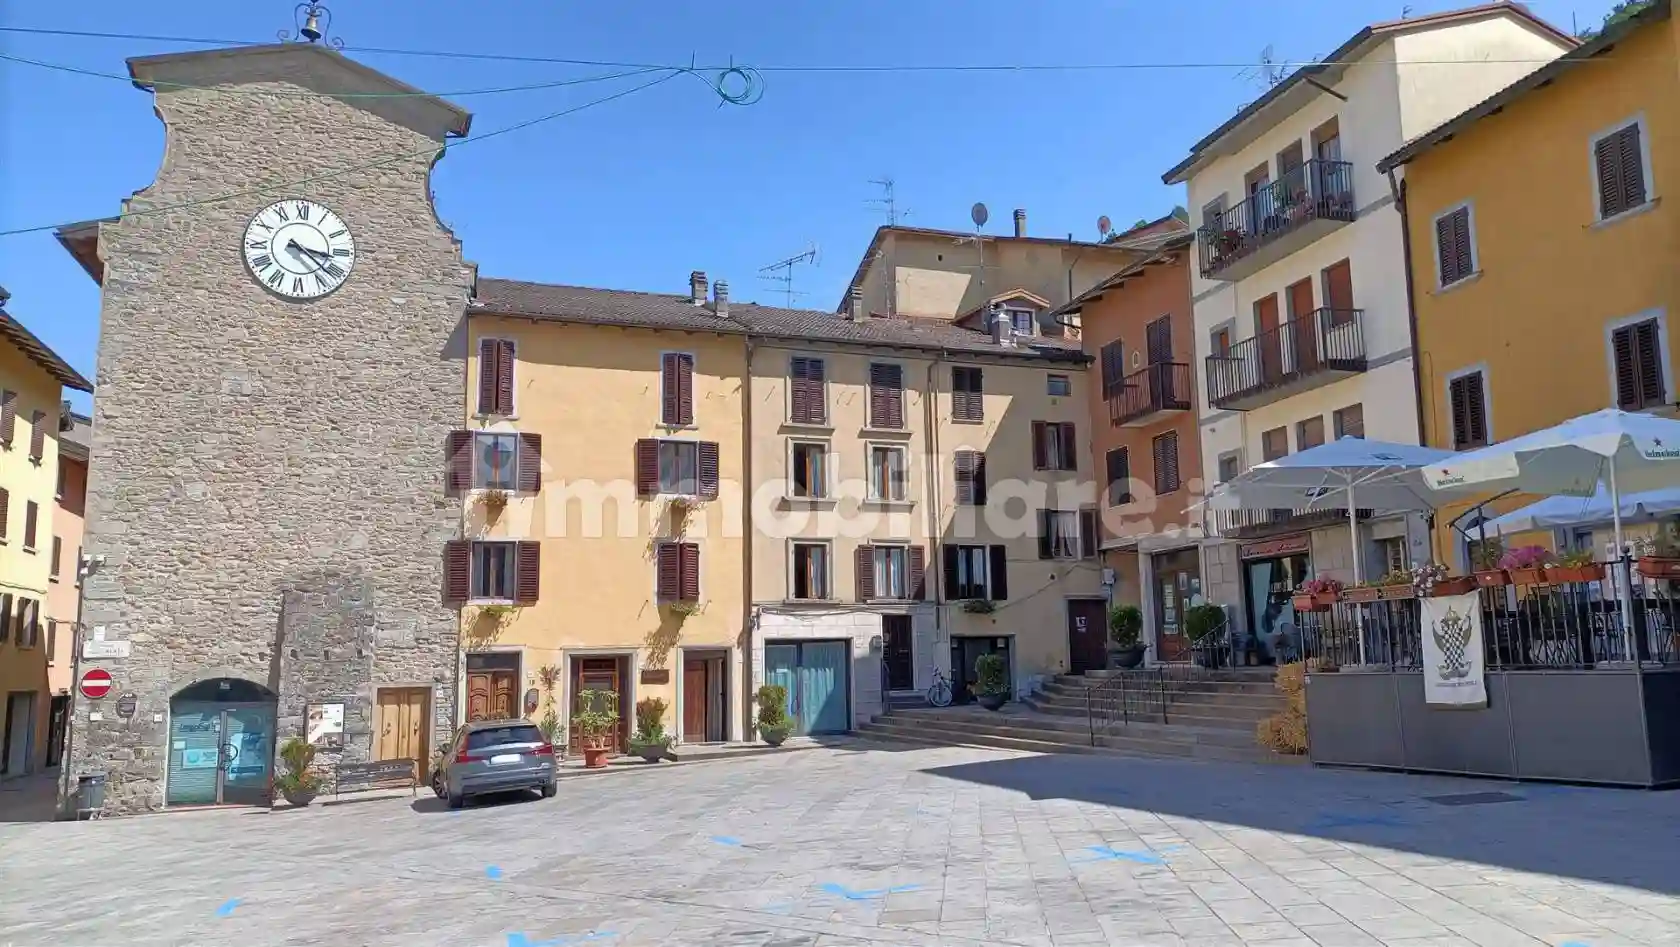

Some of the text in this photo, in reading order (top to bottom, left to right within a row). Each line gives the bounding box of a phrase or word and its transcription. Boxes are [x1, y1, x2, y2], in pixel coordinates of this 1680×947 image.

[273, 206, 289, 223] XI
[296, 204, 309, 220] XII
[256, 219, 274, 234] X
[329, 230, 345, 239] II
[250, 240, 267, 249] IX
[333, 248, 350, 257] III
[252, 255, 273, 273] VIII
[268, 269, 285, 288] VII
[293, 277, 304, 293] VI
